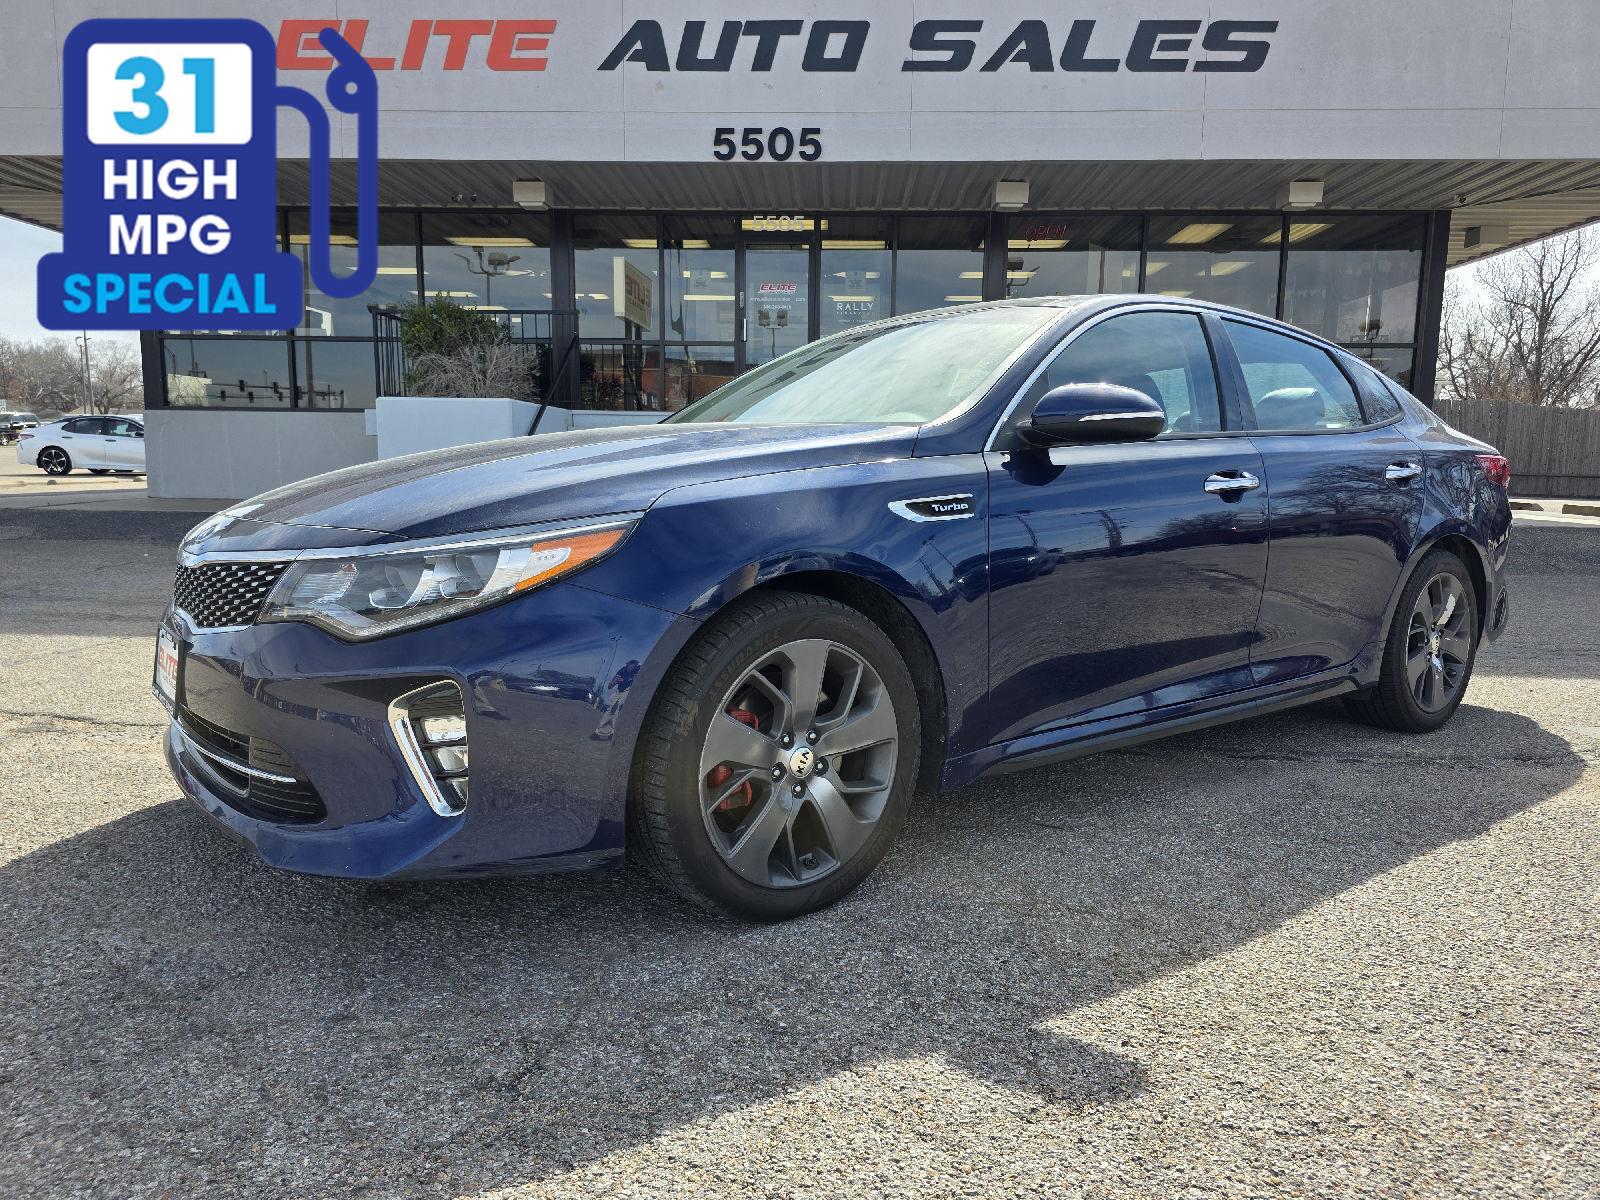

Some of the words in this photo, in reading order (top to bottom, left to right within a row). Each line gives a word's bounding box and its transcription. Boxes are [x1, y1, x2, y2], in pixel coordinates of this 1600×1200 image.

[276, 19, 557, 72] ELITE
[597, 20, 871, 72] AUTO
[901, 20, 1279, 73] SALES
[713, 127, 823, 162] 5505
[752, 215, 805, 232] 5505
[760, 283, 798, 292] ELITE
[836, 302, 874, 311] RALLY
[931, 502, 969, 512] Turbo
